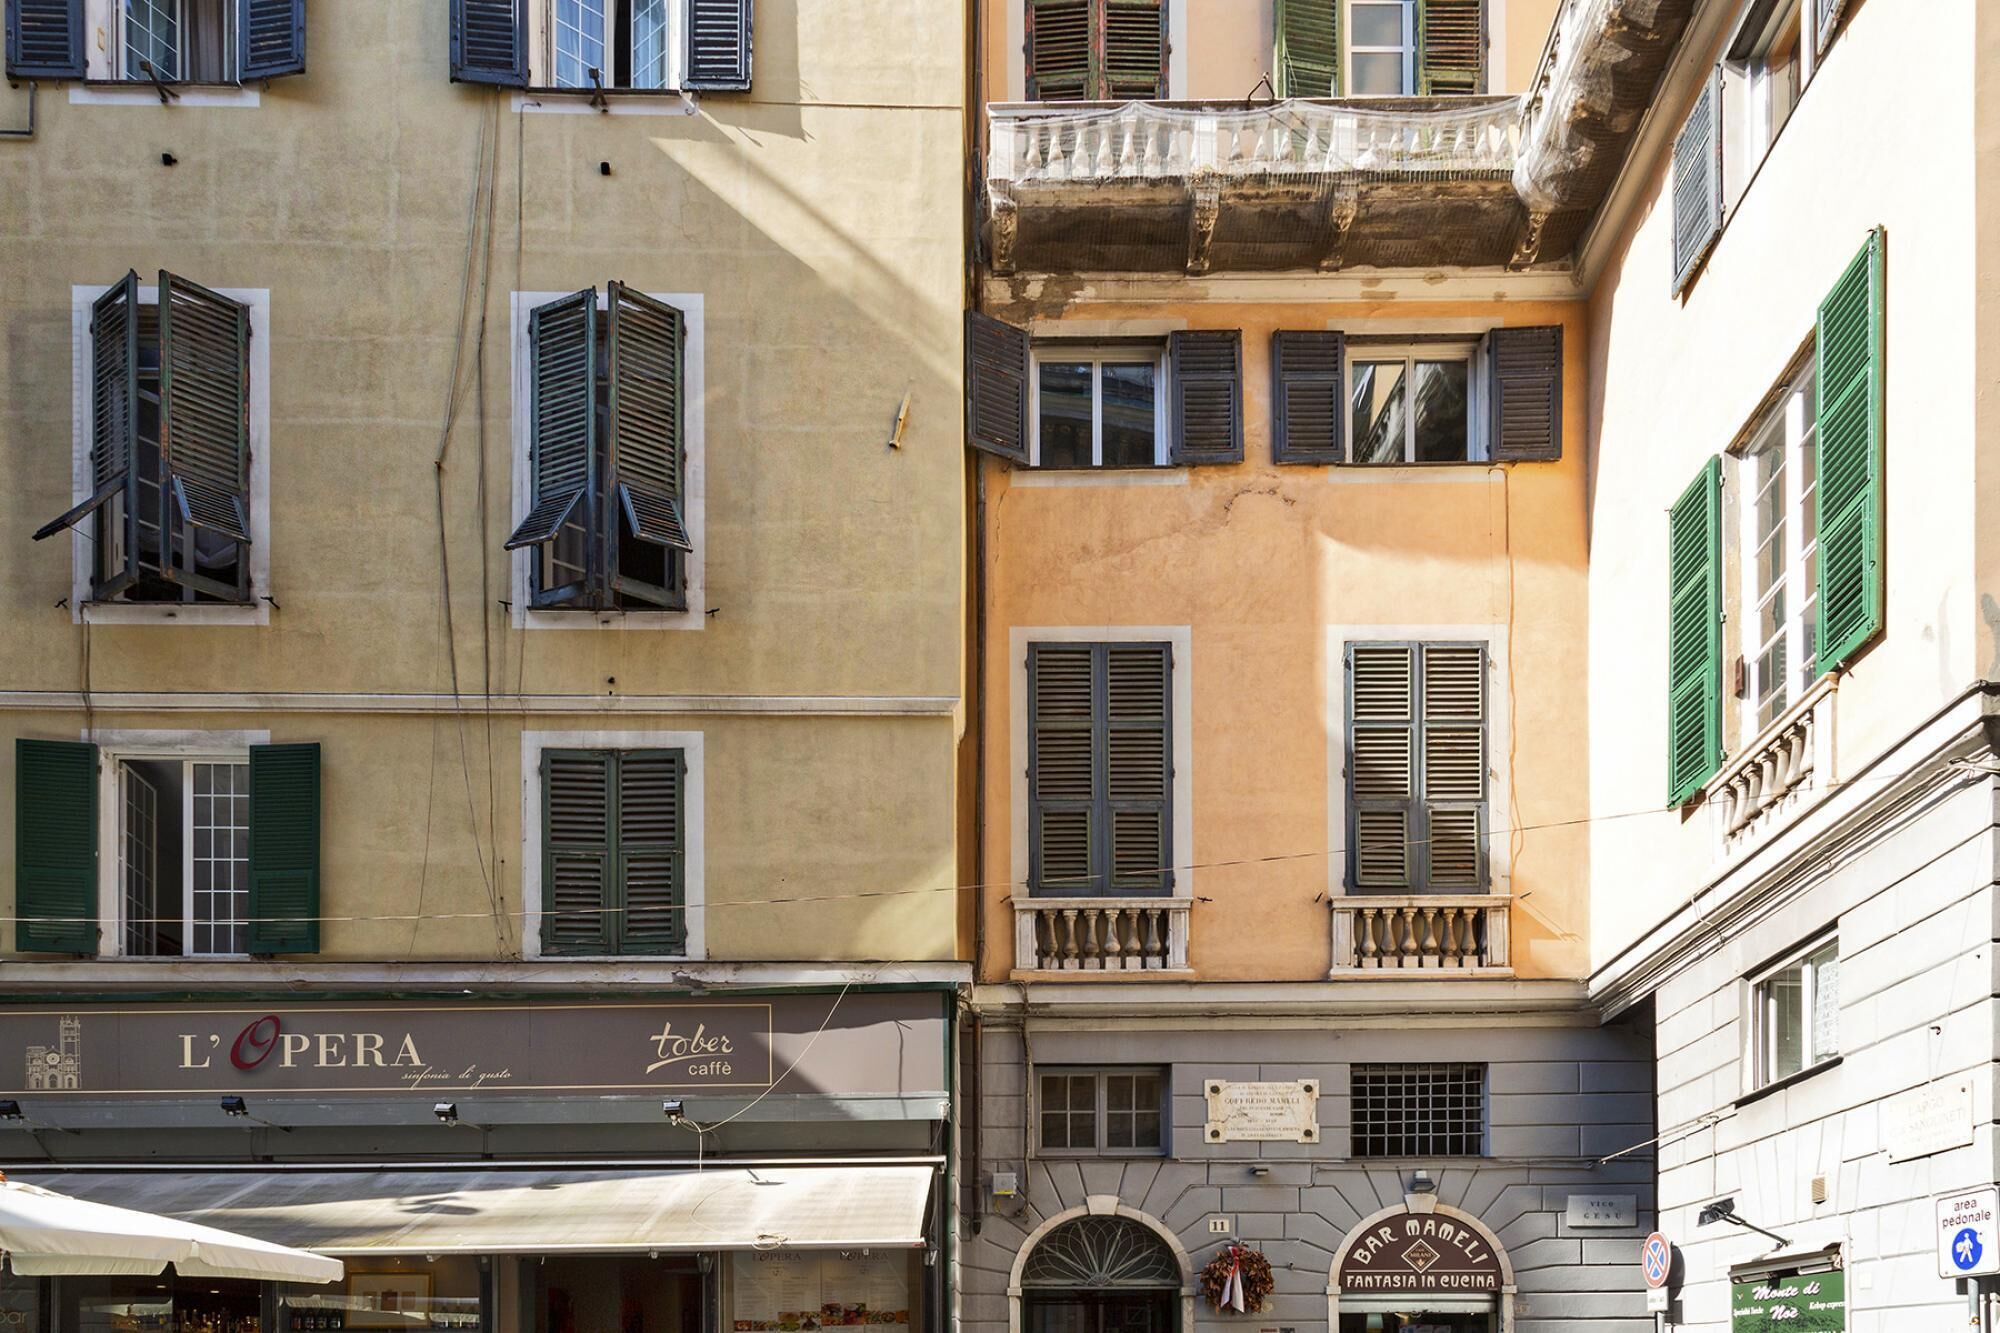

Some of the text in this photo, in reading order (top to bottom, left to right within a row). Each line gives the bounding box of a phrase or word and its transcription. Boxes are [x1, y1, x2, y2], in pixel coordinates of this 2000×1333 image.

[178, 1015, 426, 1070] L'OPERA
[650, 1022, 734, 1059] tober
[401, 1065, 513, 1089] sinfonia di gusto
[688, 1061, 732, 1076] caffè
[1954, 1199, 1977, 1212] area
[1211, 1221, 1225, 1231] 11
[1942, 1210, 1991, 1229] pedonale
[1353, 1219, 1489, 1265] BAR MAMELI
[1346, 1275, 1496, 1288] FANTASIA IN CUCINA
[1752, 1281, 1820, 1301] Monte di
[1769, 1304, 1799, 1320] Noè
